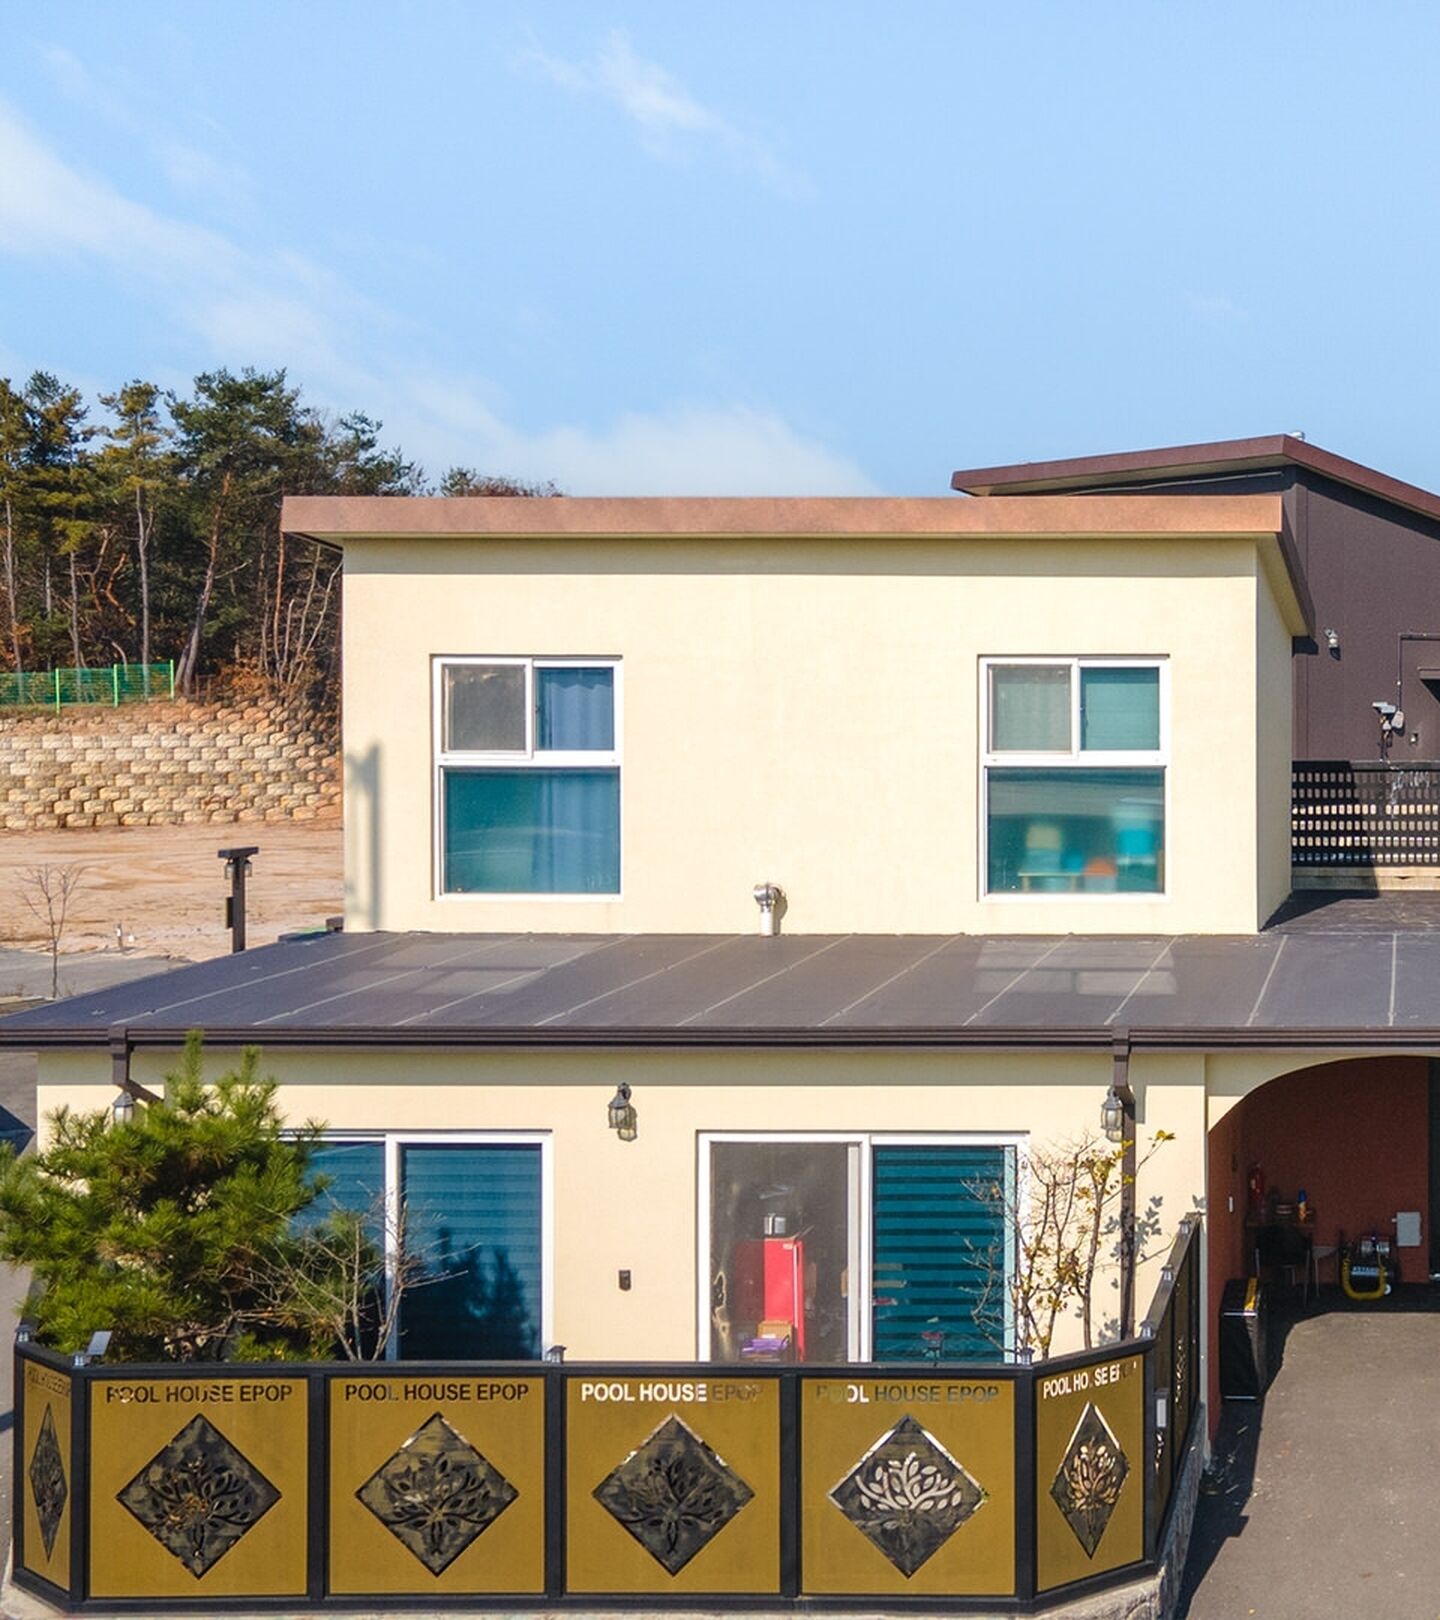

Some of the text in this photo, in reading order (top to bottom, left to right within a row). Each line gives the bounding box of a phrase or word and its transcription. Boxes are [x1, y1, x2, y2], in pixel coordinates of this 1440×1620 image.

[1043, 1376, 1072, 1400] POOL
[1073, 1366, 1108, 1392] HOSE
[106, 1385, 293, 1403] POOL HOUSE EPOP
[345, 1384, 529, 1401] POOL HOUSE EPOP
[581, 1383, 636, 1402] POOL
[640, 1383, 707, 1402] HOUSE
[875, 1385, 941, 1402] HOUSE
[947, 1385, 999, 1402] EPOP
